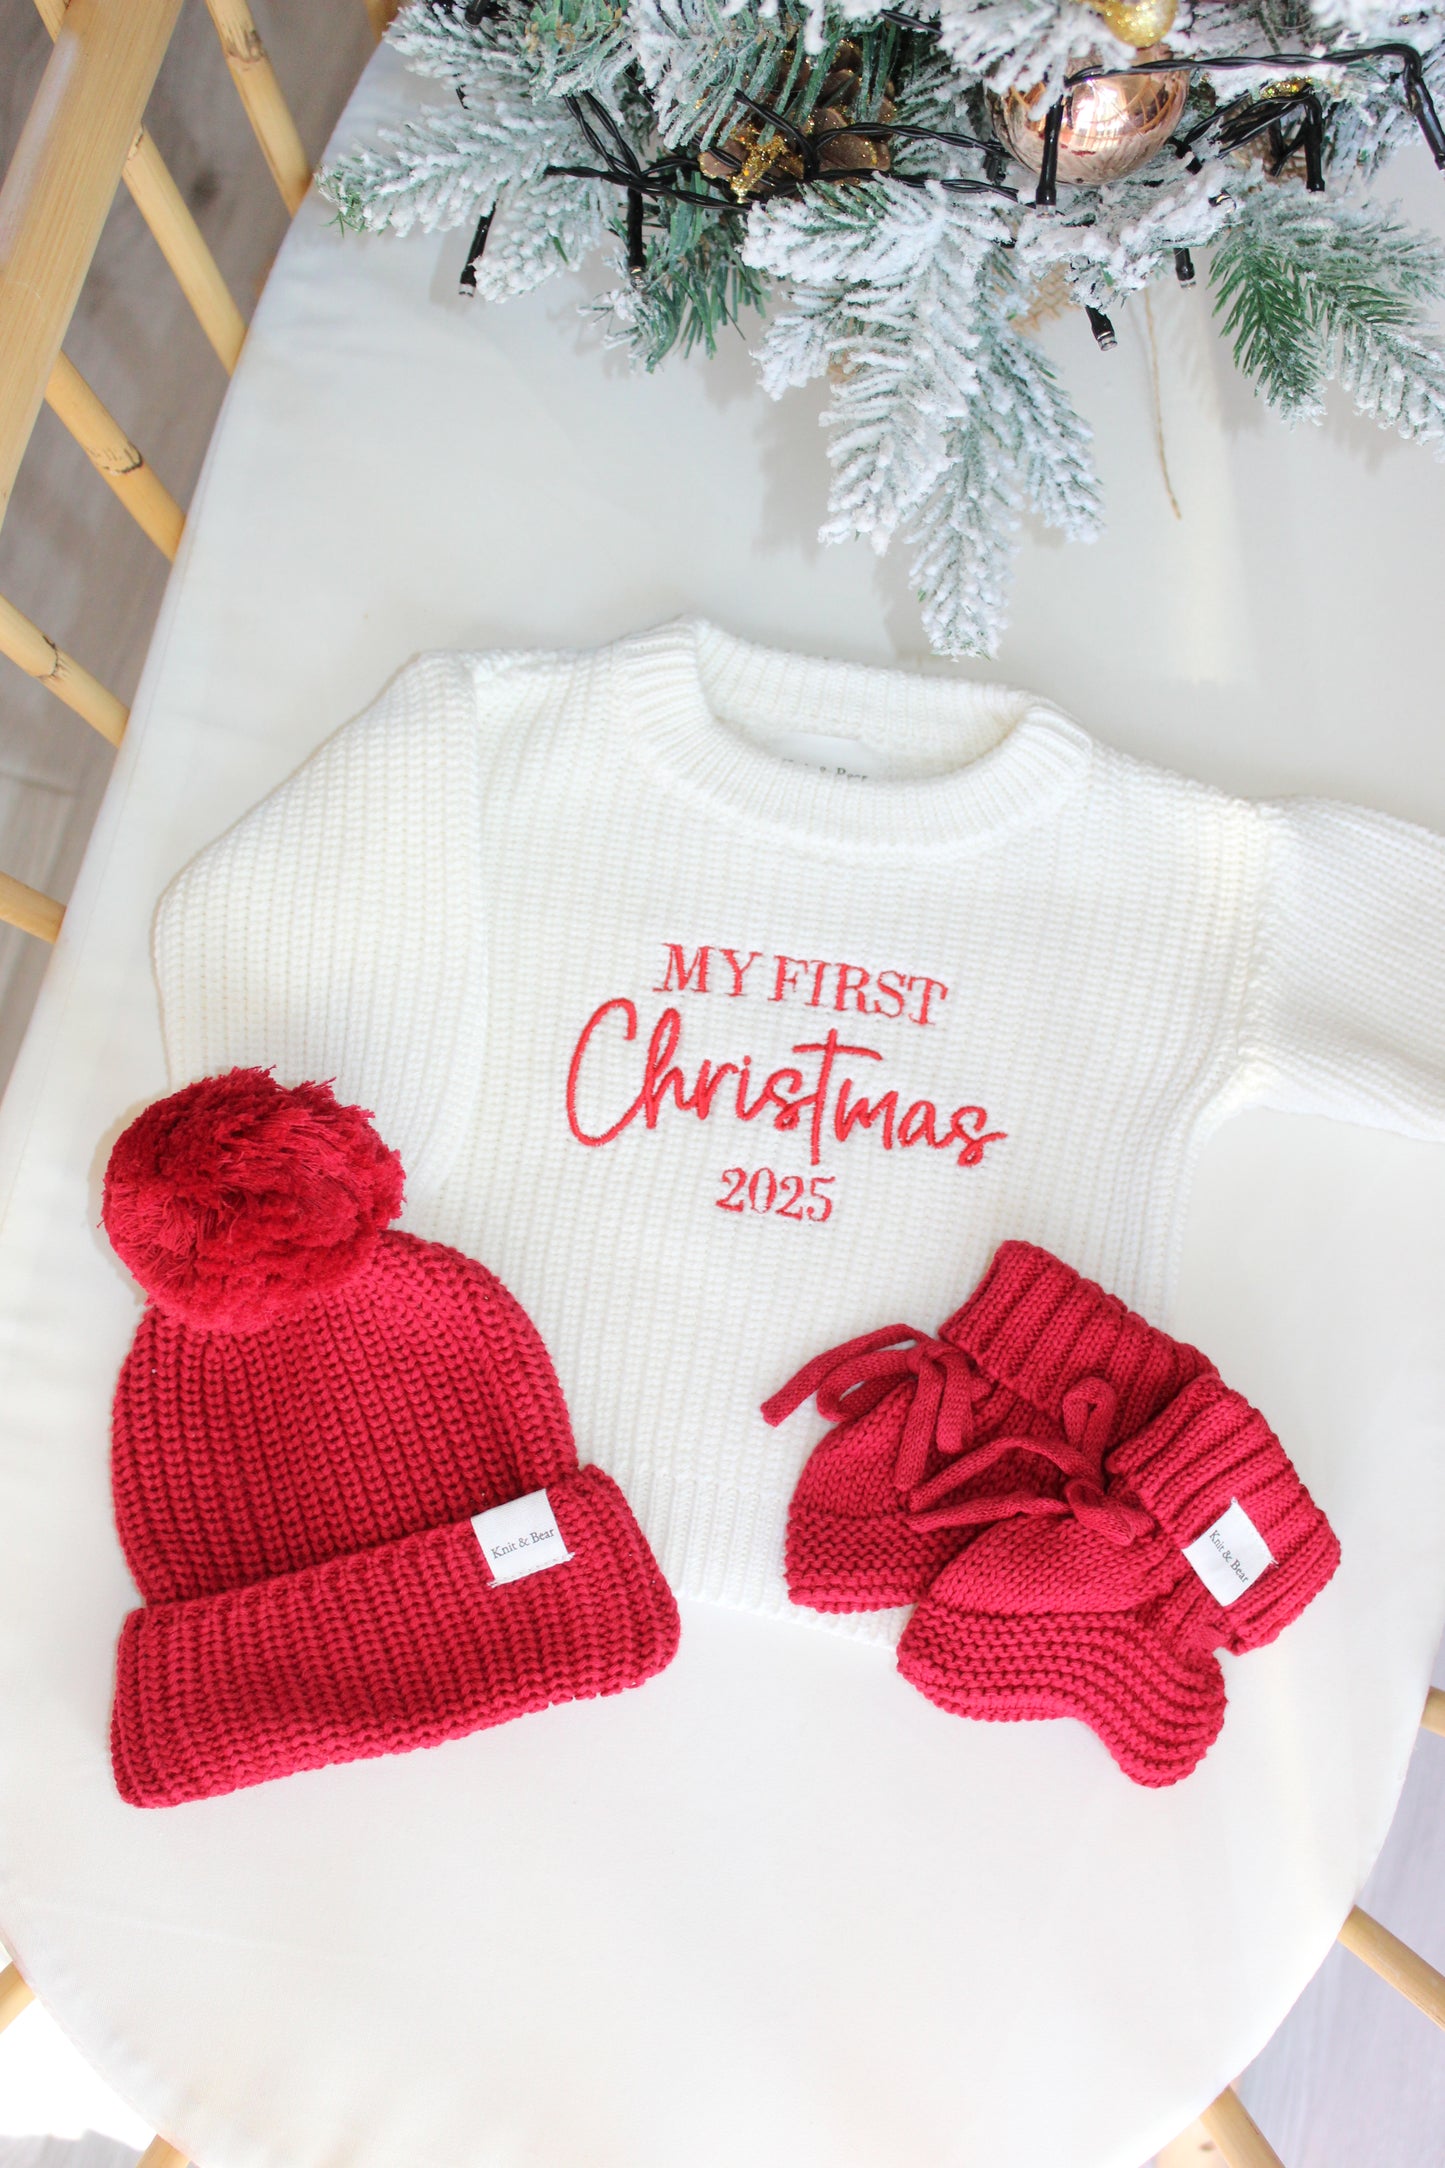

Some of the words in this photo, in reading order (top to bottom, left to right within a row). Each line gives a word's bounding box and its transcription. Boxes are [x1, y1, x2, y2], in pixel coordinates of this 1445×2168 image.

[652, 942, 762, 996] MY
[768, 955, 949, 1026] FIRST
[566, 998, 1008, 1167] Christmas
[715, 1167, 836, 1223] 2025
[491, 1542, 517, 1559] Knit
[518, 1537, 530, 1548] &
[529, 1528, 554, 1543] Bear
[1209, 1530, 1225, 1552] Knit
[1222, 1550, 1232, 1563] &
[1230, 1558, 1249, 1583] Bear
